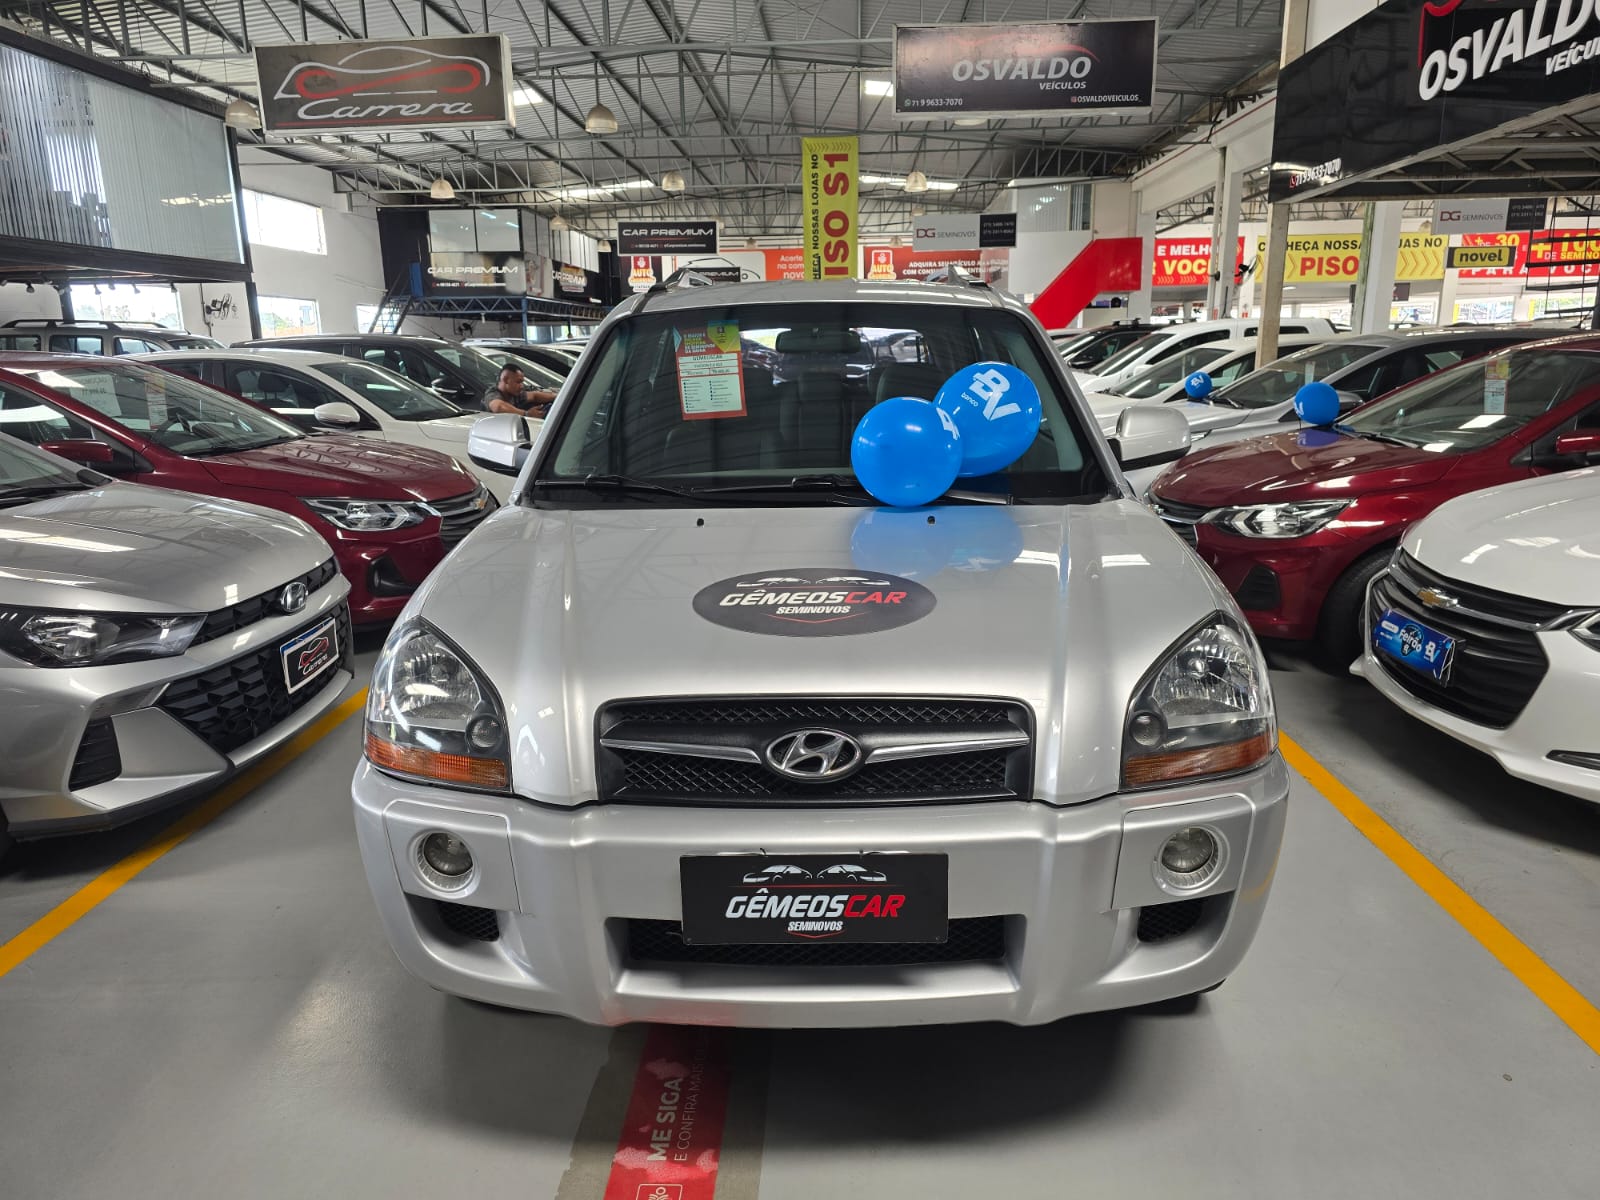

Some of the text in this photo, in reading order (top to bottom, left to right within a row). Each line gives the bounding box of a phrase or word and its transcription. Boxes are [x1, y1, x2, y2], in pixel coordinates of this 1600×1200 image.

[1418, 0, 1600, 101] OSVALD
[952, 56, 1092, 82] OSVALDO
[1039, 80, 1087, 90] VEÍCULOS
[297, 98, 474, 120] Carrera
[926, 98, 963, 106] 9633-7070
[811, 154, 819, 170] NO
[811, 172, 819, 206] LOJAS
[822, 153, 850, 276] ISO S1
[1462, 213, 1504, 222] SEMINOVOS
[650, 228, 714, 236] PREMIUM
[812, 209, 820, 249] NOSSAS
[937, 231, 976, 239] SEMINOVOS
[1157, 244, 1212, 256] E MELH
[1424, 238, 1443, 248] NO
[1460, 248, 1503, 263] novel
[427, 266, 518, 274] CAR PREMIUM
[1163, 258, 1211, 276] VOC
[1300, 255, 1360, 277] PISO
[960, 392, 979, 407] banco
[719, 589, 907, 606] GÊMEOSCAR
[776, 605, 852, 615] SEMINOVOS
[725, 887, 906, 919] GÊMEOSCAR
[787, 920, 843, 932] SEMINOVOS
[647, 1078, 684, 1161] ME SIGA
[677, 1093, 699, 1150] CONFIRA
[673, 1152, 688, 1161] E
